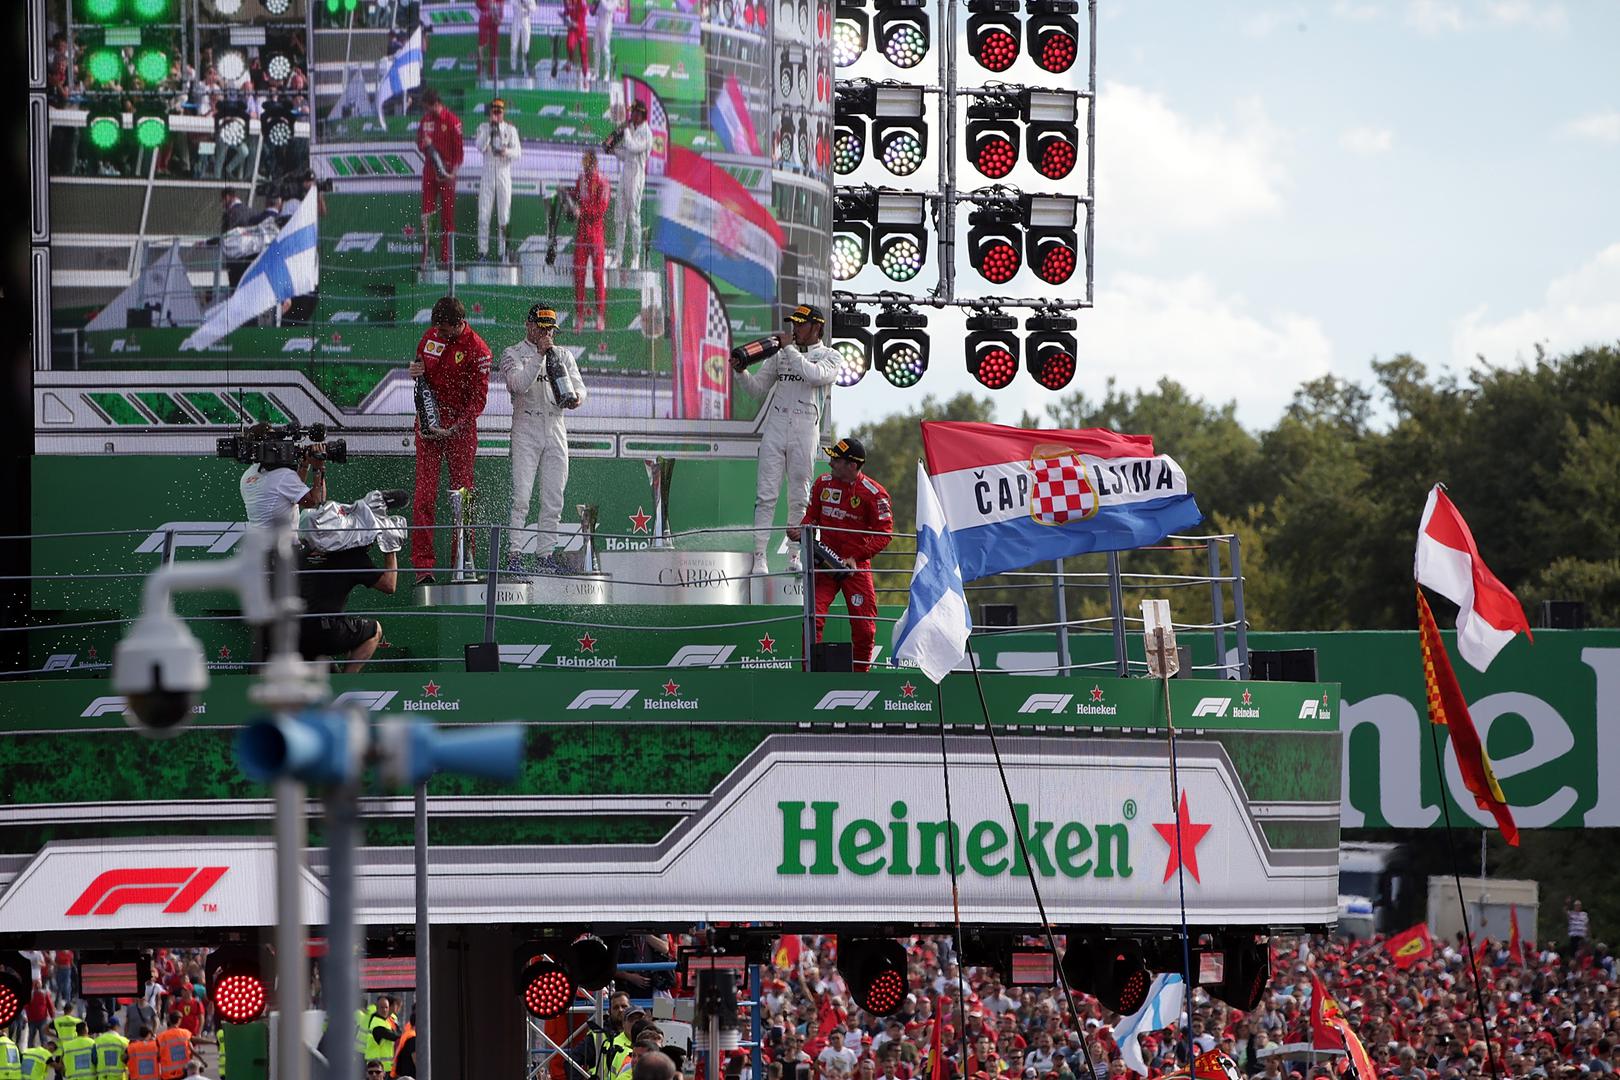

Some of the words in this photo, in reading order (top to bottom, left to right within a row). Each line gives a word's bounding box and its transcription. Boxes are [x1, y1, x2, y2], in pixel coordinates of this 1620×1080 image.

[658, 567, 730, 588] CARBON
[480, 590, 525, 603] CRBON
[403, 699, 460, 711] Heineken
[643, 698, 699, 710] Heineken
[884, 700, 933, 712] Heineken
[1076, 703, 1118, 716] Heineken
[1232, 707, 1261, 719] Heineken
[776, 800, 1138, 879] Heineken
